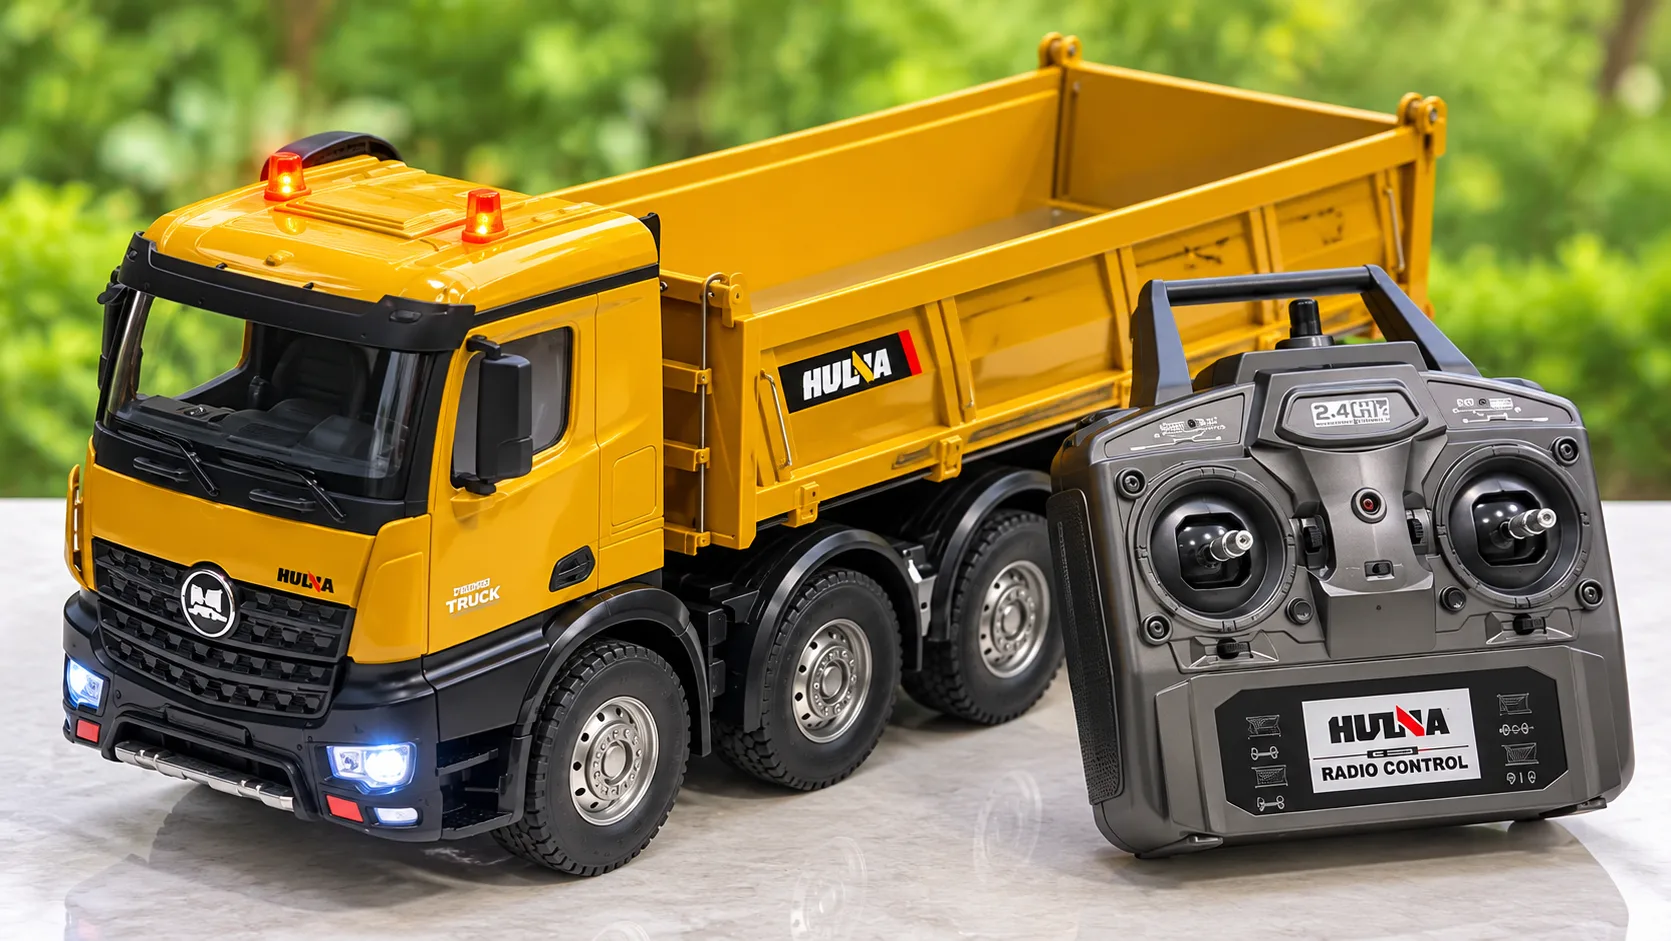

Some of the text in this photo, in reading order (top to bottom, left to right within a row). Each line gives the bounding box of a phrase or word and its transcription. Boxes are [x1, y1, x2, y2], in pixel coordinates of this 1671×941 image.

[445, 585, 501, 613] TRUCK
[1322, 755, 1469, 781] RADIO CONTROL
